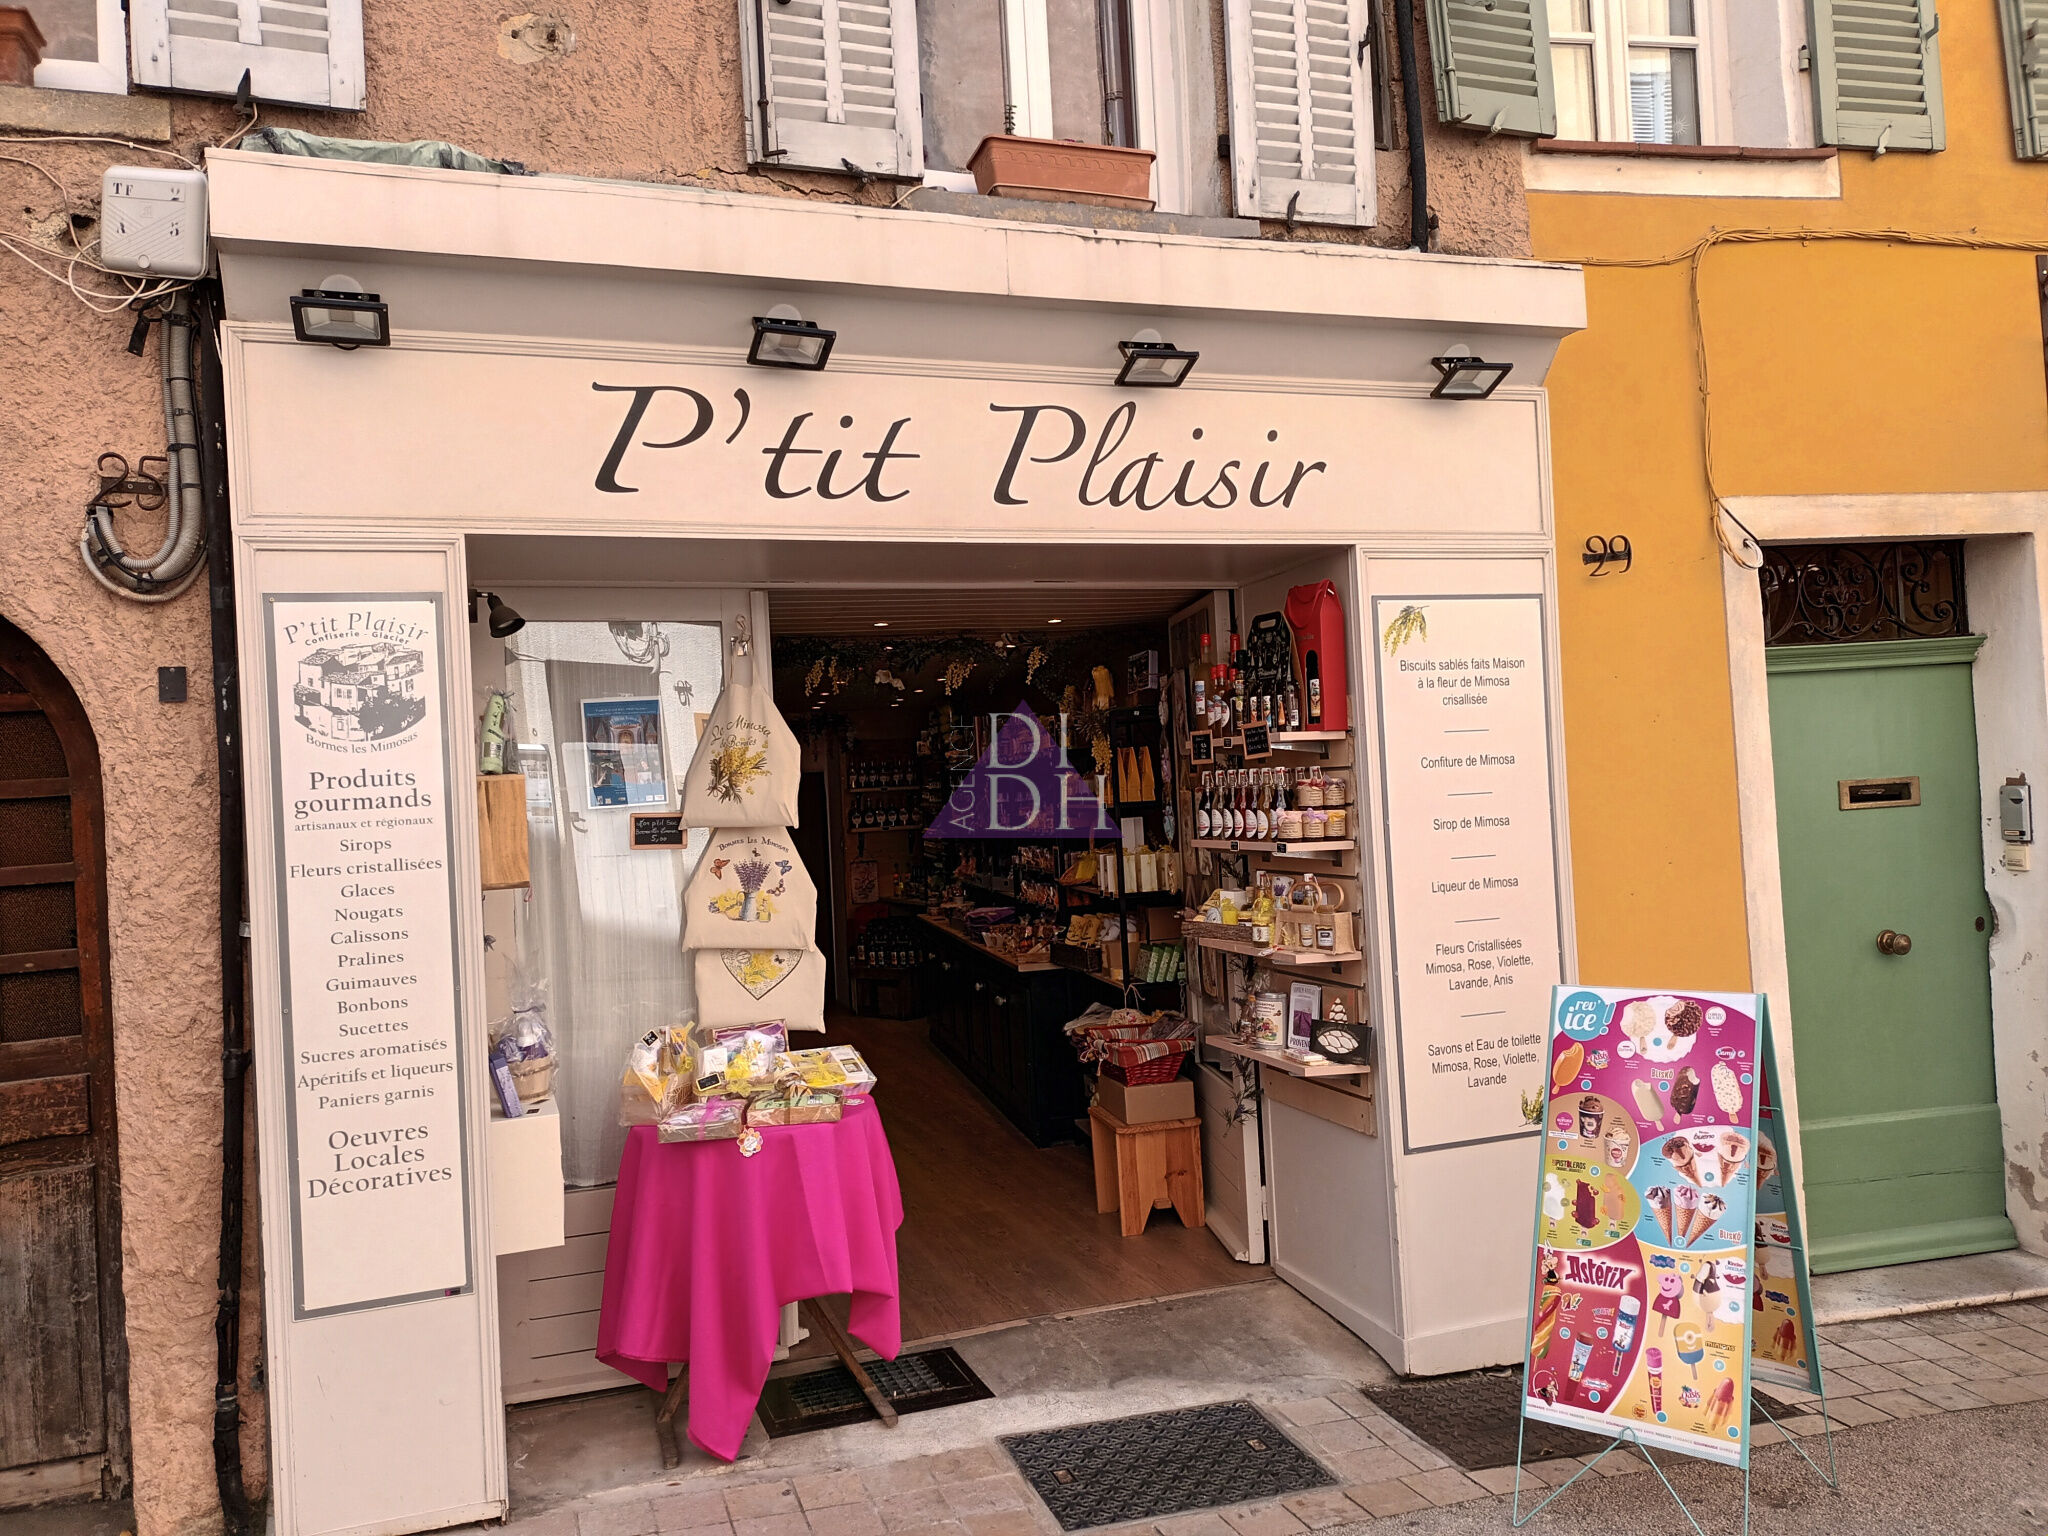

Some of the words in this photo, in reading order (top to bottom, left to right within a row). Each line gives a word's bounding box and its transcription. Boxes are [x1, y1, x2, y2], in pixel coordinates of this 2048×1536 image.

[592, 381, 921, 503] P'tit
[990, 401, 1327, 512] Plaisir
[1585, 535, 1632, 577] 29
[283, 616, 338, 645] P'tit
[348, 611, 429, 641] Plaisir
[304, 631, 360, 646] Confiserie
[371, 631, 409, 645] Glacier
[1400, 659, 1436, 672] Biscuits
[1438, 658, 1468, 671] sablés
[1471, 658, 1490, 670] faits
[1492, 657, 1525, 670] Maison
[1418, 677, 1424, 689] à
[1426, 678, 1435, 689] la
[1437, 677, 1458, 689] fleur
[1460, 676, 1472, 688] de
[1474, 675, 1510, 687] Mimosa
[1442, 693, 1488, 706] crisallisée
[727, 715, 771, 736] Mimosa
[306, 733, 348, 754] Bormes
[351, 744, 367, 754] les
[370, 732, 418, 753] Mimosas
[1420, 755, 1463, 769] Confiture
[1465, 755, 1477, 767] de
[1479, 754, 1515, 766] Mimosa
[310, 768, 416, 790] Produits
[294, 788, 432, 819] gourmands
[294, 821, 357, 832] artisanaux
[360, 818, 372, 828] et
[376, 816, 433, 829] régionaux
[1433, 818, 1458, 832] Sirop
[1460, 817, 1472, 829] de
[1474, 816, 1510, 828] Mimosa
[340, 839, 392, 854] Sirops
[290, 864, 342, 878] Fleurs
[346, 858, 442, 875] cristallisées
[340, 883, 395, 898] Glaces
[1431, 880, 1467, 895] Liqueur
[1468, 878, 1481, 890] de
[1483, 876, 1519, 889] Mimosa
[335, 905, 404, 923] Nougats
[330, 929, 409, 945] Calissons
[1435, 942, 1465, 955] Fleurs
[1467, 937, 1522, 953] Cristallisées
[338, 952, 404, 968] Pralines
[1425, 961, 1465, 975] Mimosa,
[1467, 958, 1495, 972] Rose,
[1496, 955, 1534, 969] Violette,
[326, 973, 418, 992] Guimauves
[1448, 977, 1492, 991] Lavande,
[1494, 974, 1514, 986] Anis
[337, 997, 408, 1014] Bonbons
[339, 1020, 409, 1037] Sucettes
[300, 1049, 355, 1064] Sucres
[360, 1038, 448, 1058] aromatisés
[1428, 1043, 1463, 1057] Savons
[1464, 1041, 1475, 1052] et
[1476, 1038, 1495, 1051] Eau
[1497, 1037, 1510, 1049] de
[1511, 1033, 1542, 1048] toilette
[1432, 1059, 1471, 1074] Mimosa,
[1473, 1056, 1500, 1069] Rose,
[1502, 1052, 1540, 1066] Violette,
[297, 1067, 368, 1091] Apéritifs
[371, 1068, 386, 1080] et
[391, 1061, 454, 1080] liqueurs
[1467, 1073, 1507, 1088] Lavande
[319, 1091, 380, 1110] Paniers
[385, 1086, 435, 1106] garnis
[328, 1125, 429, 1150] Oeuvres
[334, 1145, 425, 1172] Locales
[307, 1166, 453, 1199] Décoratives
[1565, 1255, 1633, 1290] Astérix
